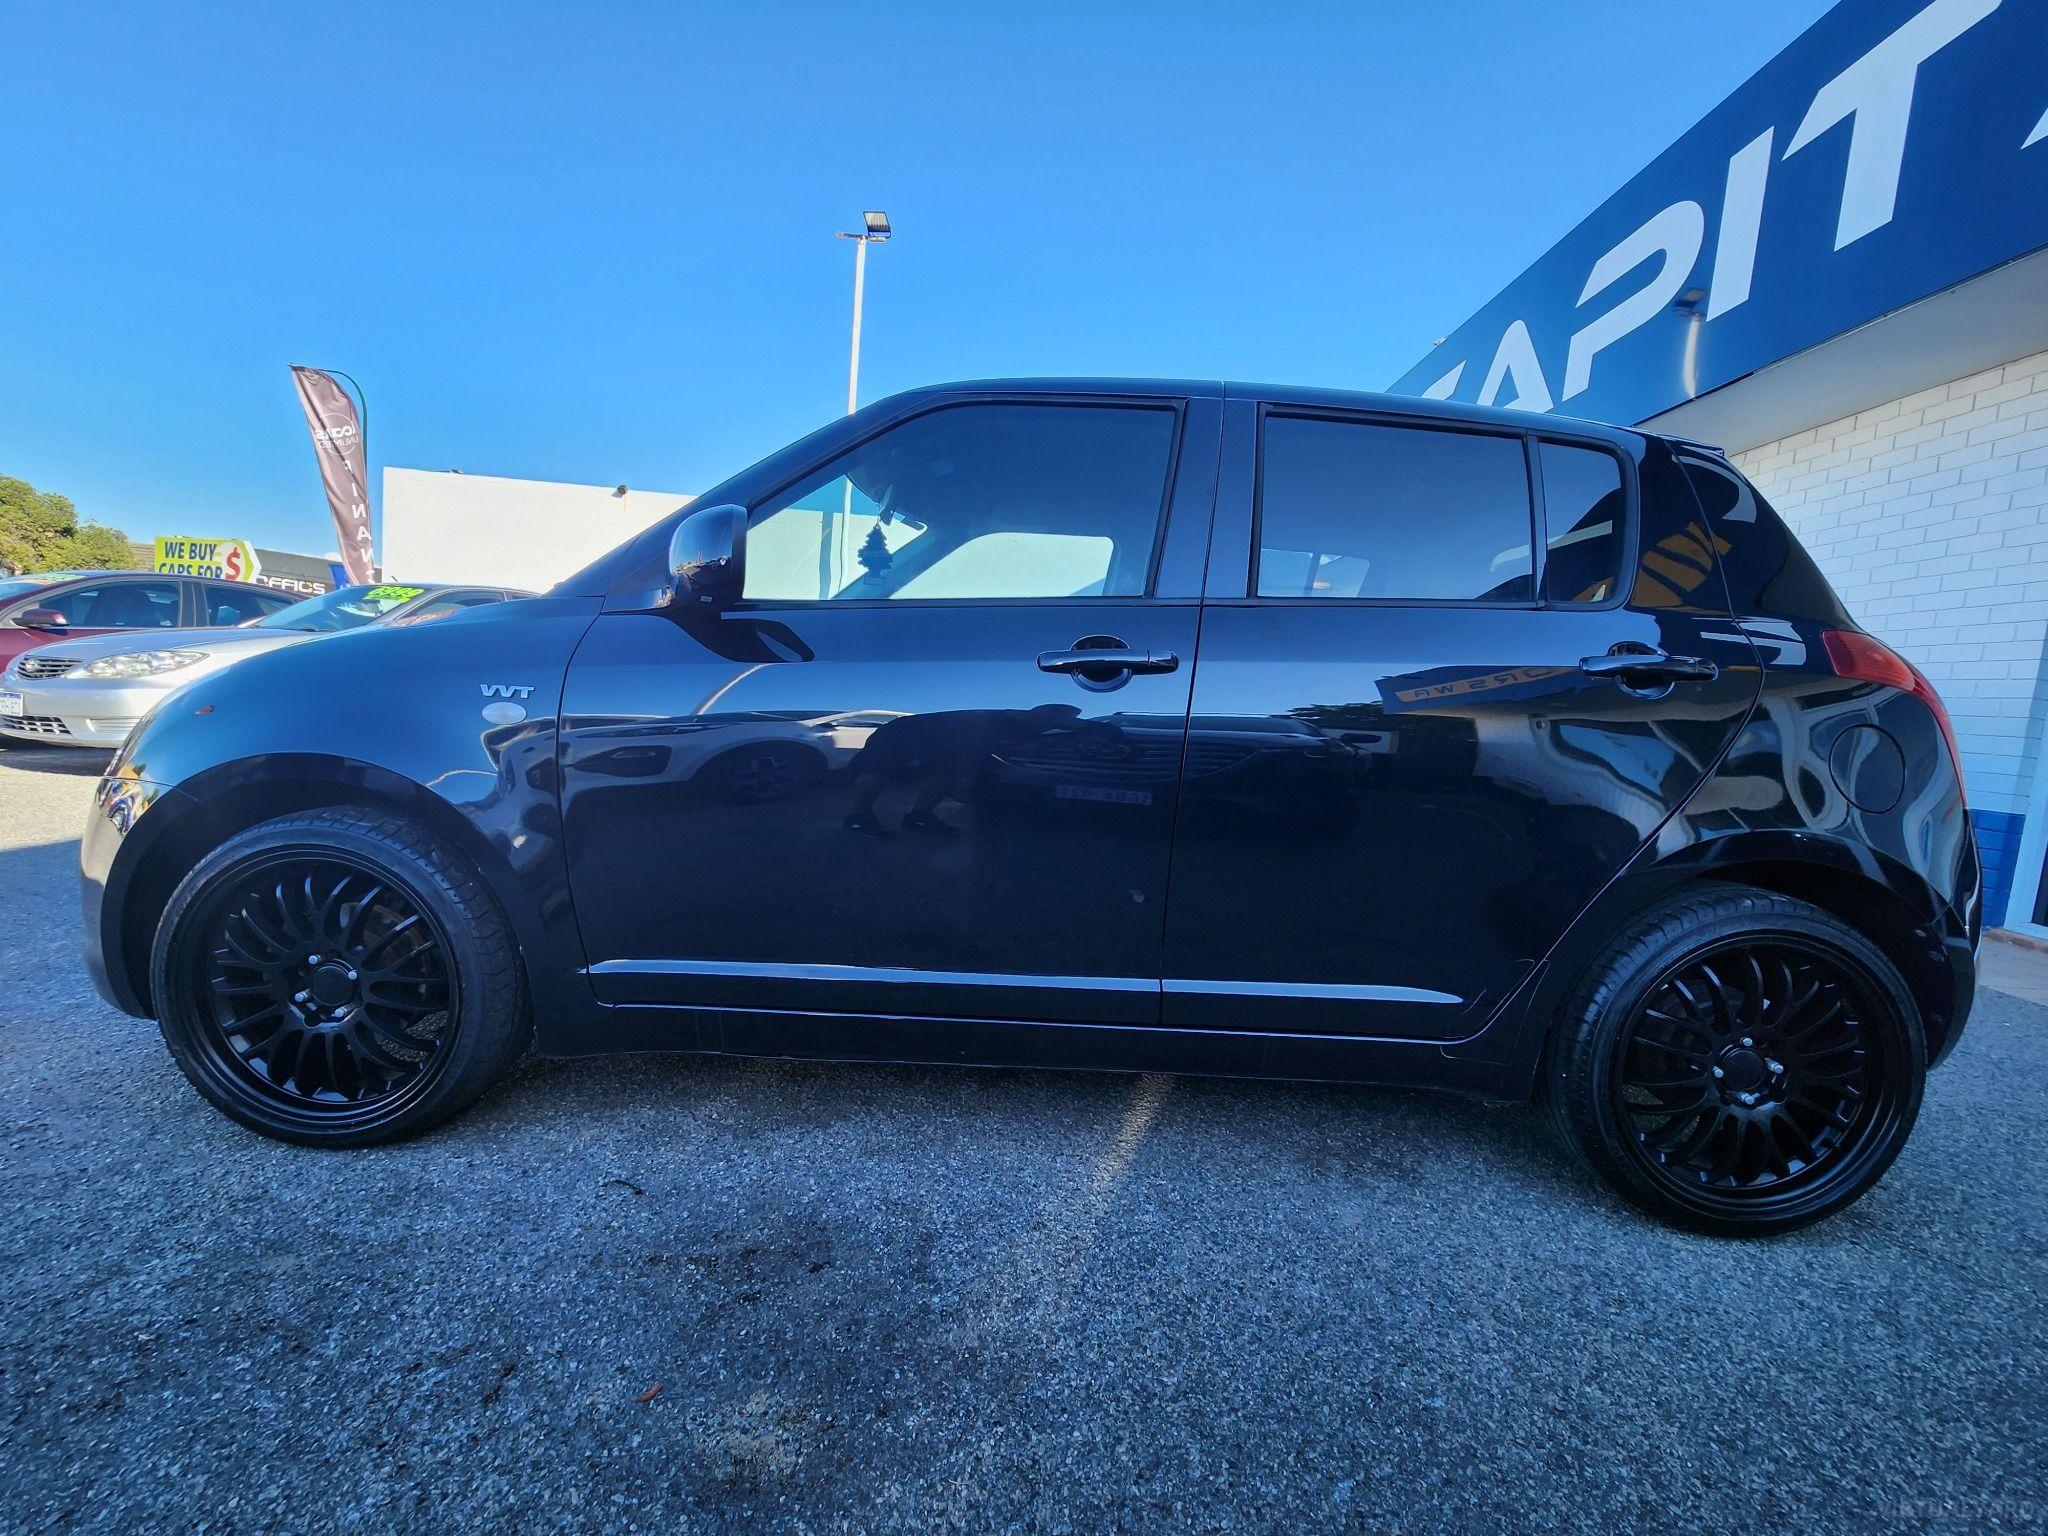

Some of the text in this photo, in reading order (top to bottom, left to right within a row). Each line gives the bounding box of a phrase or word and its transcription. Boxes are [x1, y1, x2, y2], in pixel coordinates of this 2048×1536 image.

[1421, 0, 2048, 410] APIT
[164, 541, 217, 561] WE BUY
[197, 564, 223, 578] FOR
[480, 683, 535, 699] VVT
